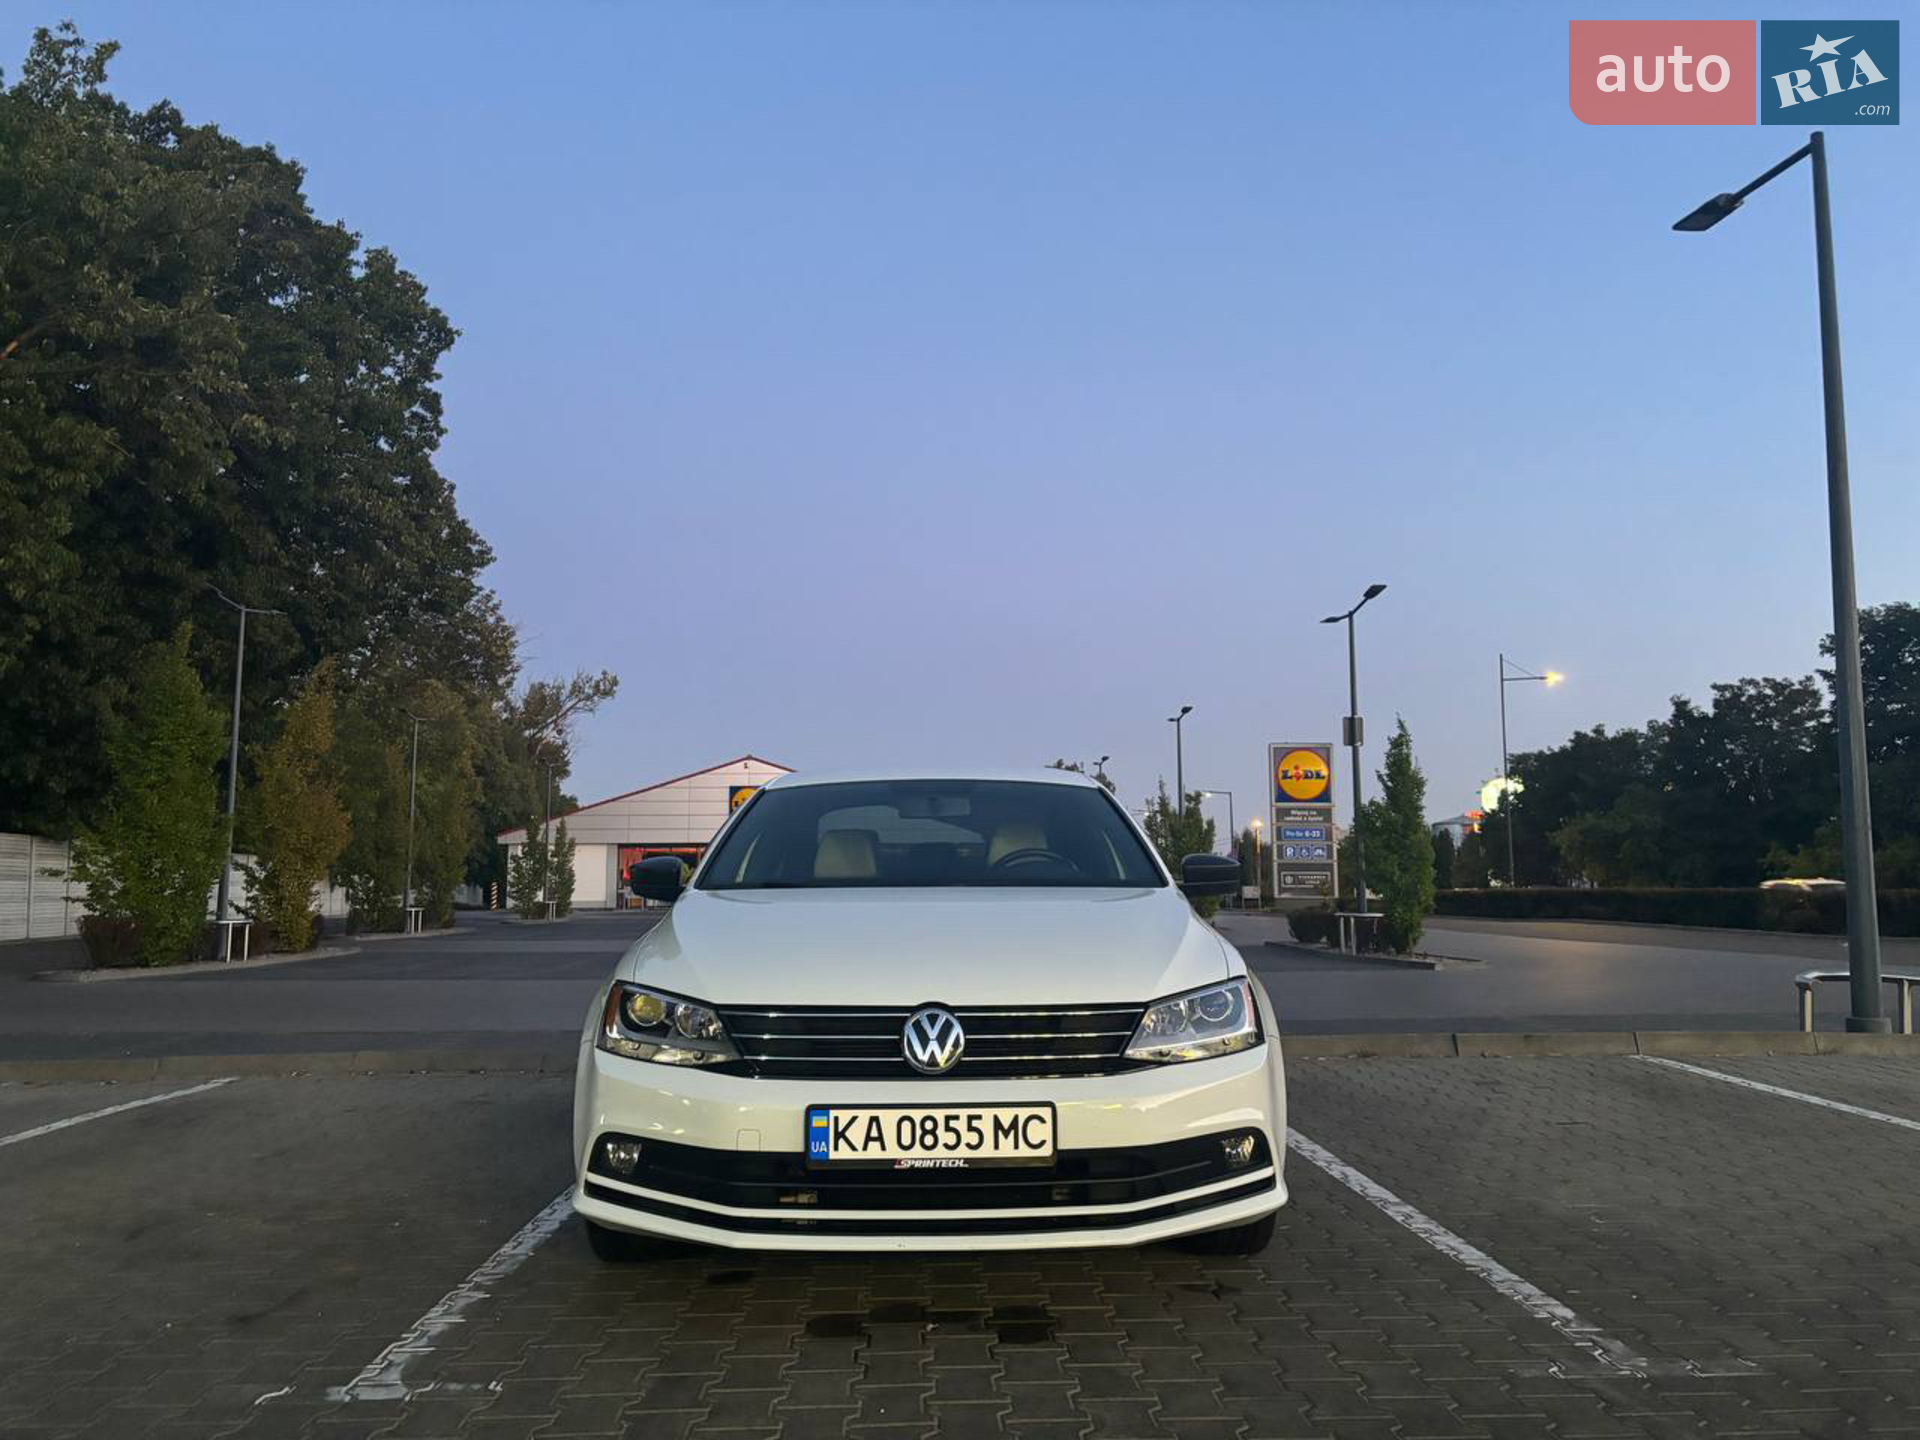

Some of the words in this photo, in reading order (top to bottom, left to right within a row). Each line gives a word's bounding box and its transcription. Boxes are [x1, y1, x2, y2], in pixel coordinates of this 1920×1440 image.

[832, 1115, 887, 1152] KA
[896, 1114, 985, 1151] 0855
[993, 1113, 1047, 1150] MC
[811, 1140, 828, 1154] UA
